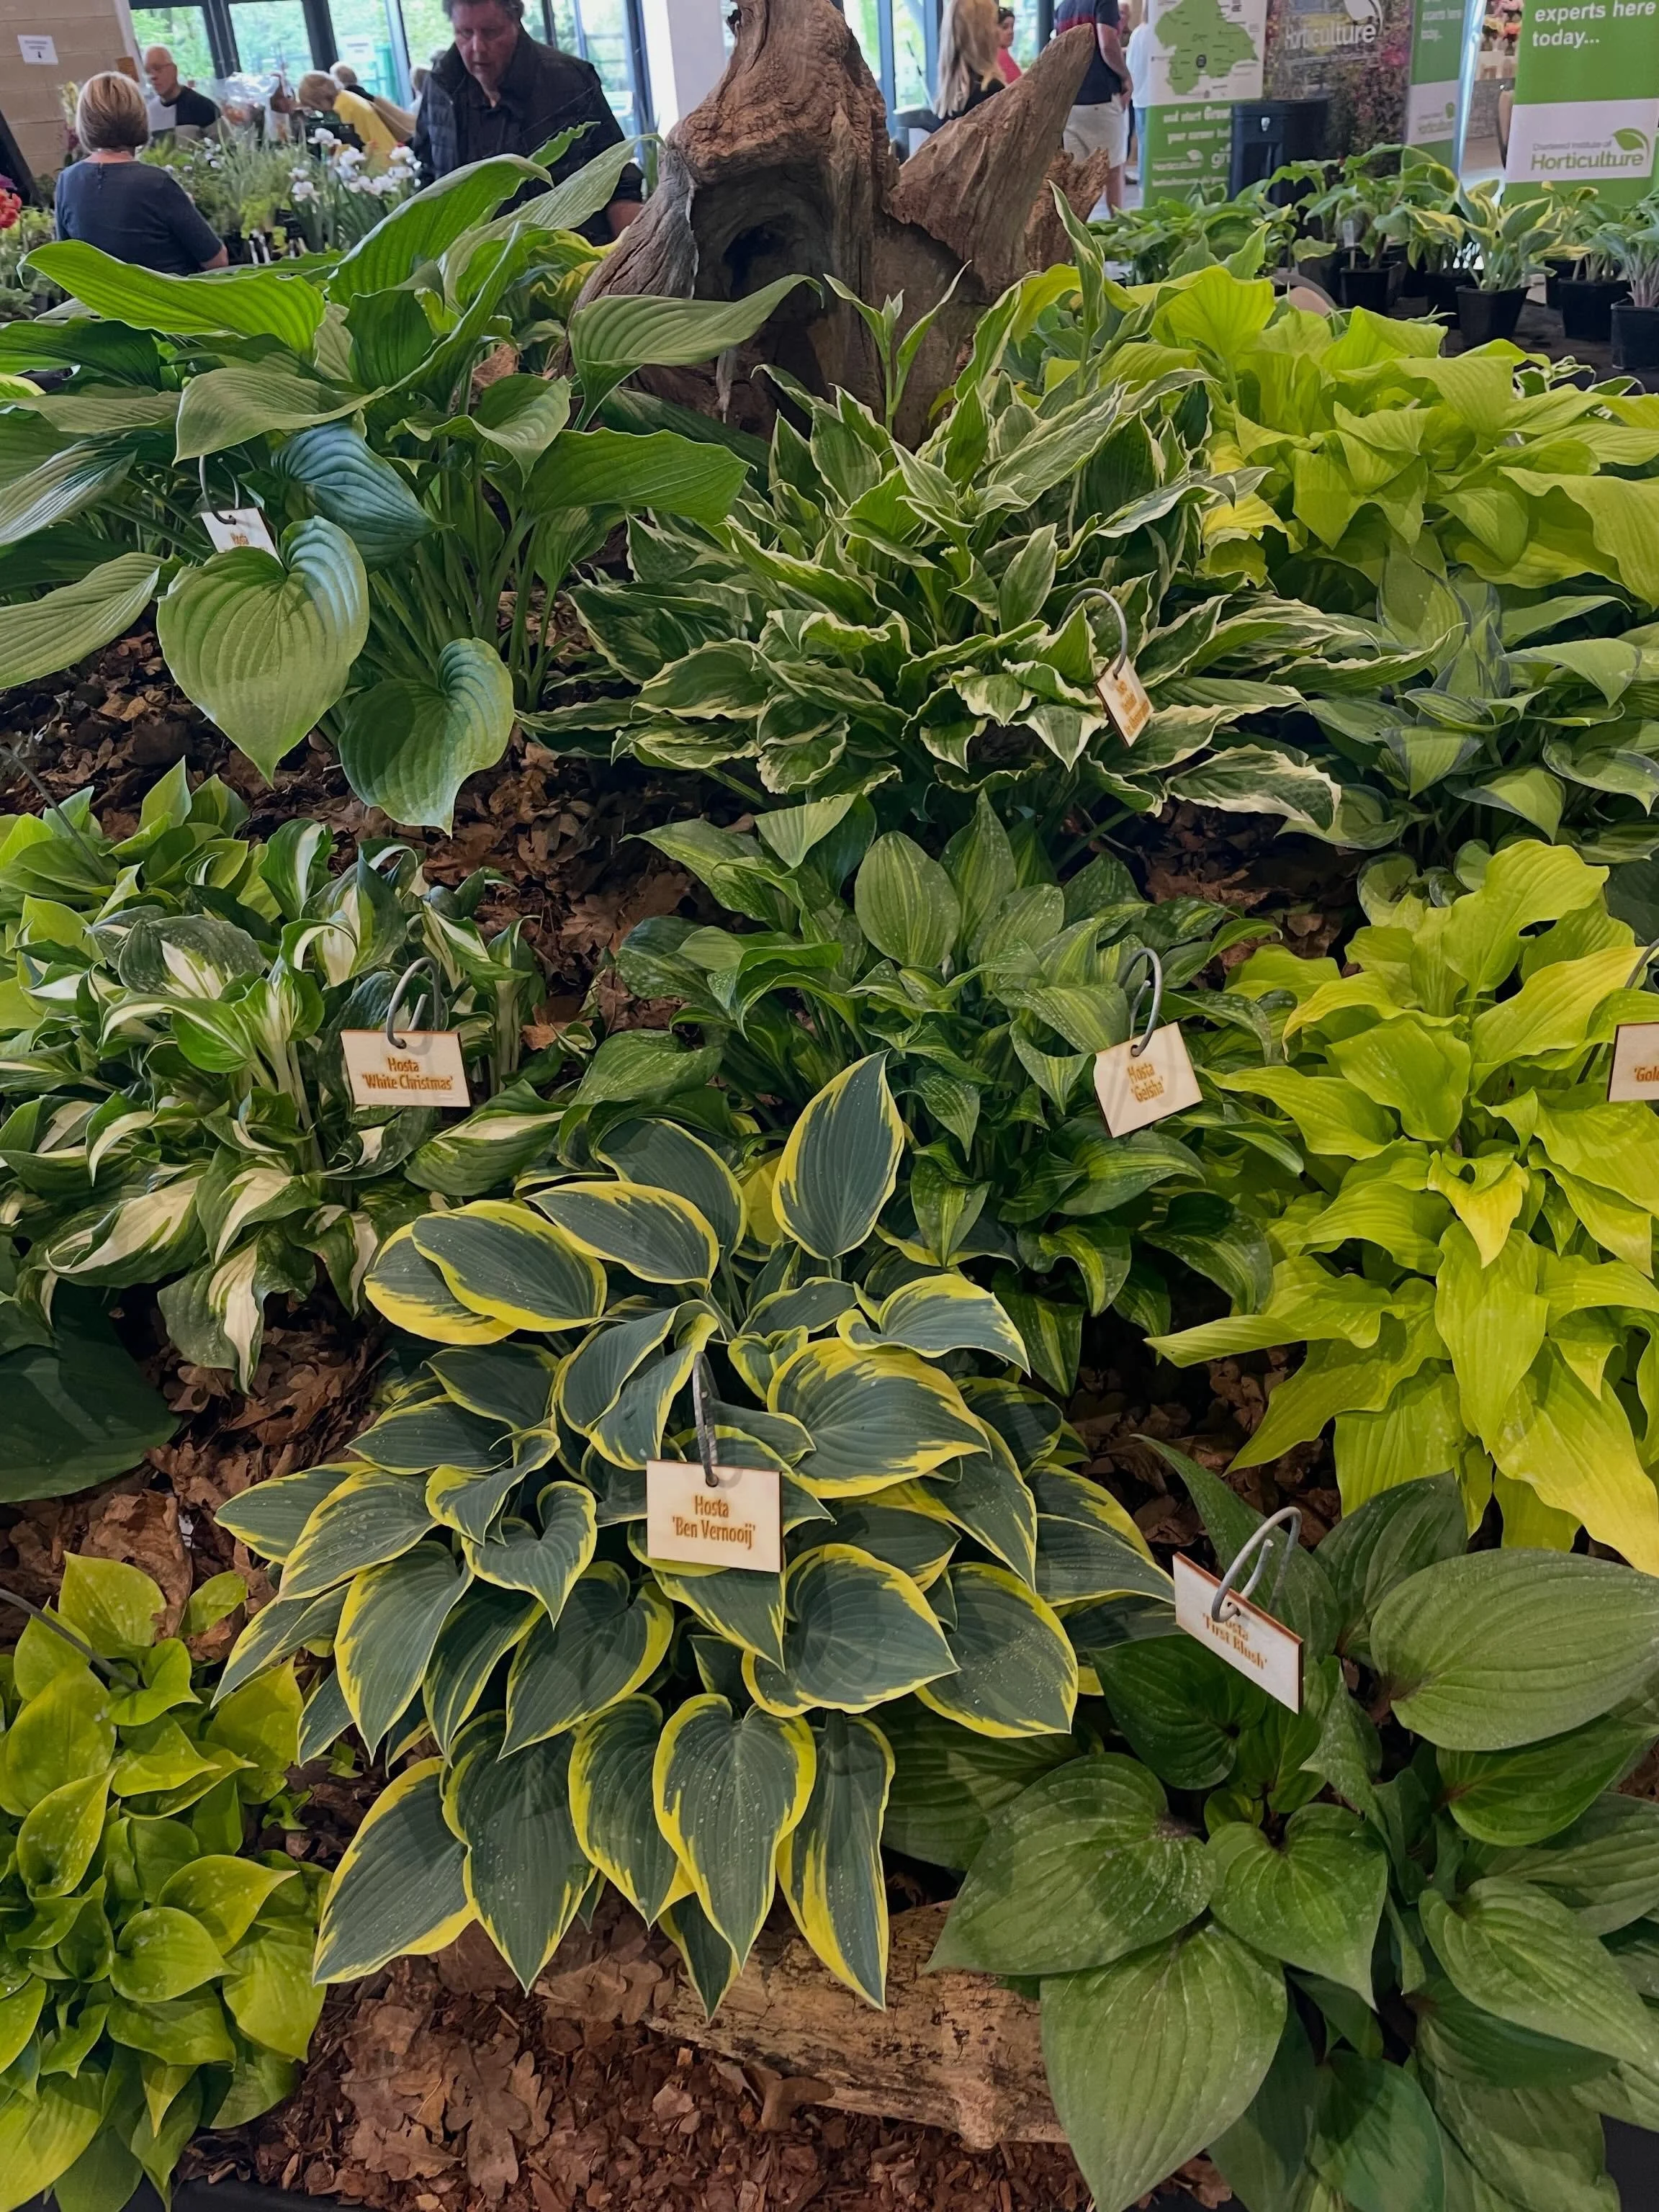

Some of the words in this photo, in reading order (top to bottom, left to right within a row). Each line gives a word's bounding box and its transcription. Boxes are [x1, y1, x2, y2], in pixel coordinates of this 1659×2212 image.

[1534, 3, 1606, 25] experts
[1612, 0, 1656, 17] here
[1532, 28, 1600, 48] today...
[1531, 150, 1643, 171] Horticulture
[387, 1057, 420, 1072] Hosta
[1128, 1063, 1155, 1083] Hosta
[362, 1074, 397, 1089] 'White
[400, 1074, 453, 1090] Christmas'
[695, 1495, 729, 1518] Hosta
[673, 1516, 697, 1538] 'Ben
[701, 1519, 755, 1550] Vernooij'
